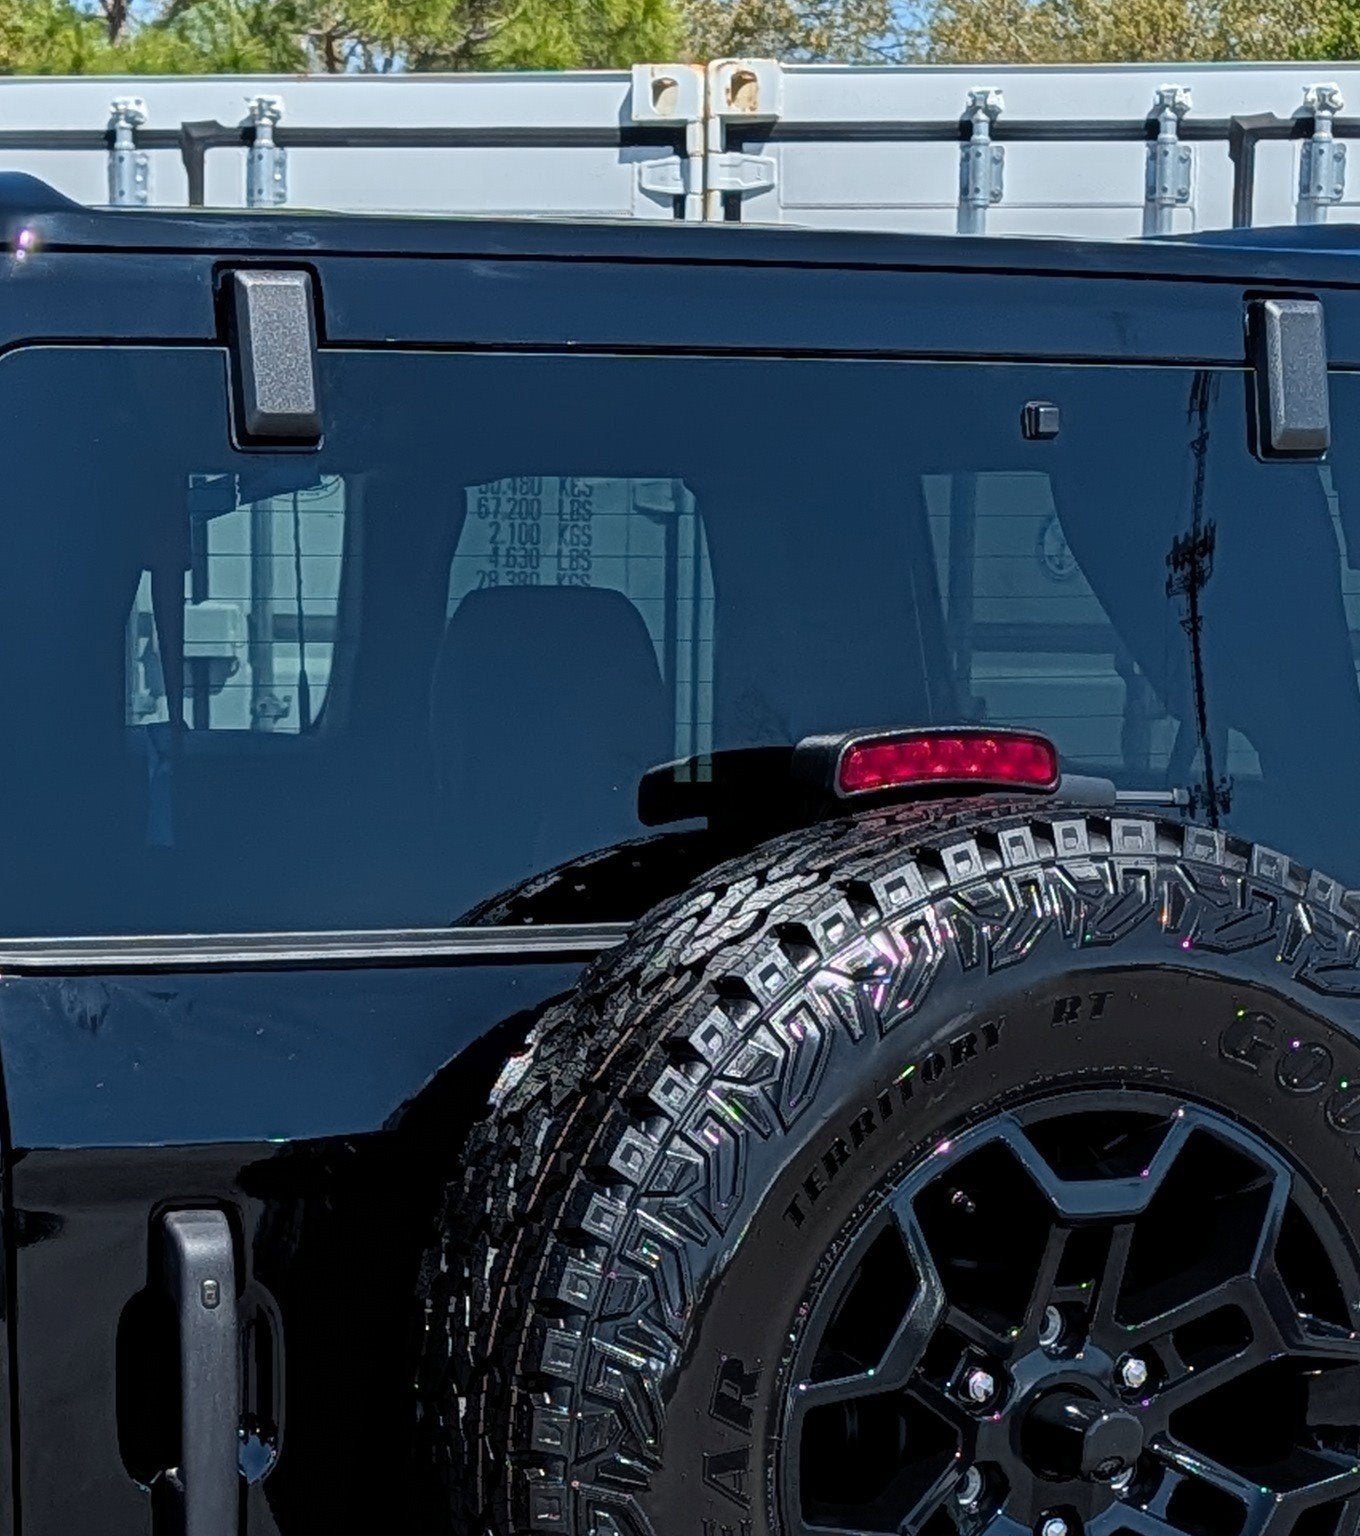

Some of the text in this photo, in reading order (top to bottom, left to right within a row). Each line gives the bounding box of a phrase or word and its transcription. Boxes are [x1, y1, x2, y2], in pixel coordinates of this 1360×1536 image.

[557, 522, 593, 547] KGS
[556, 547, 592, 572] LBS
[782, 989, 1115, 1230] TERRITORY RT
